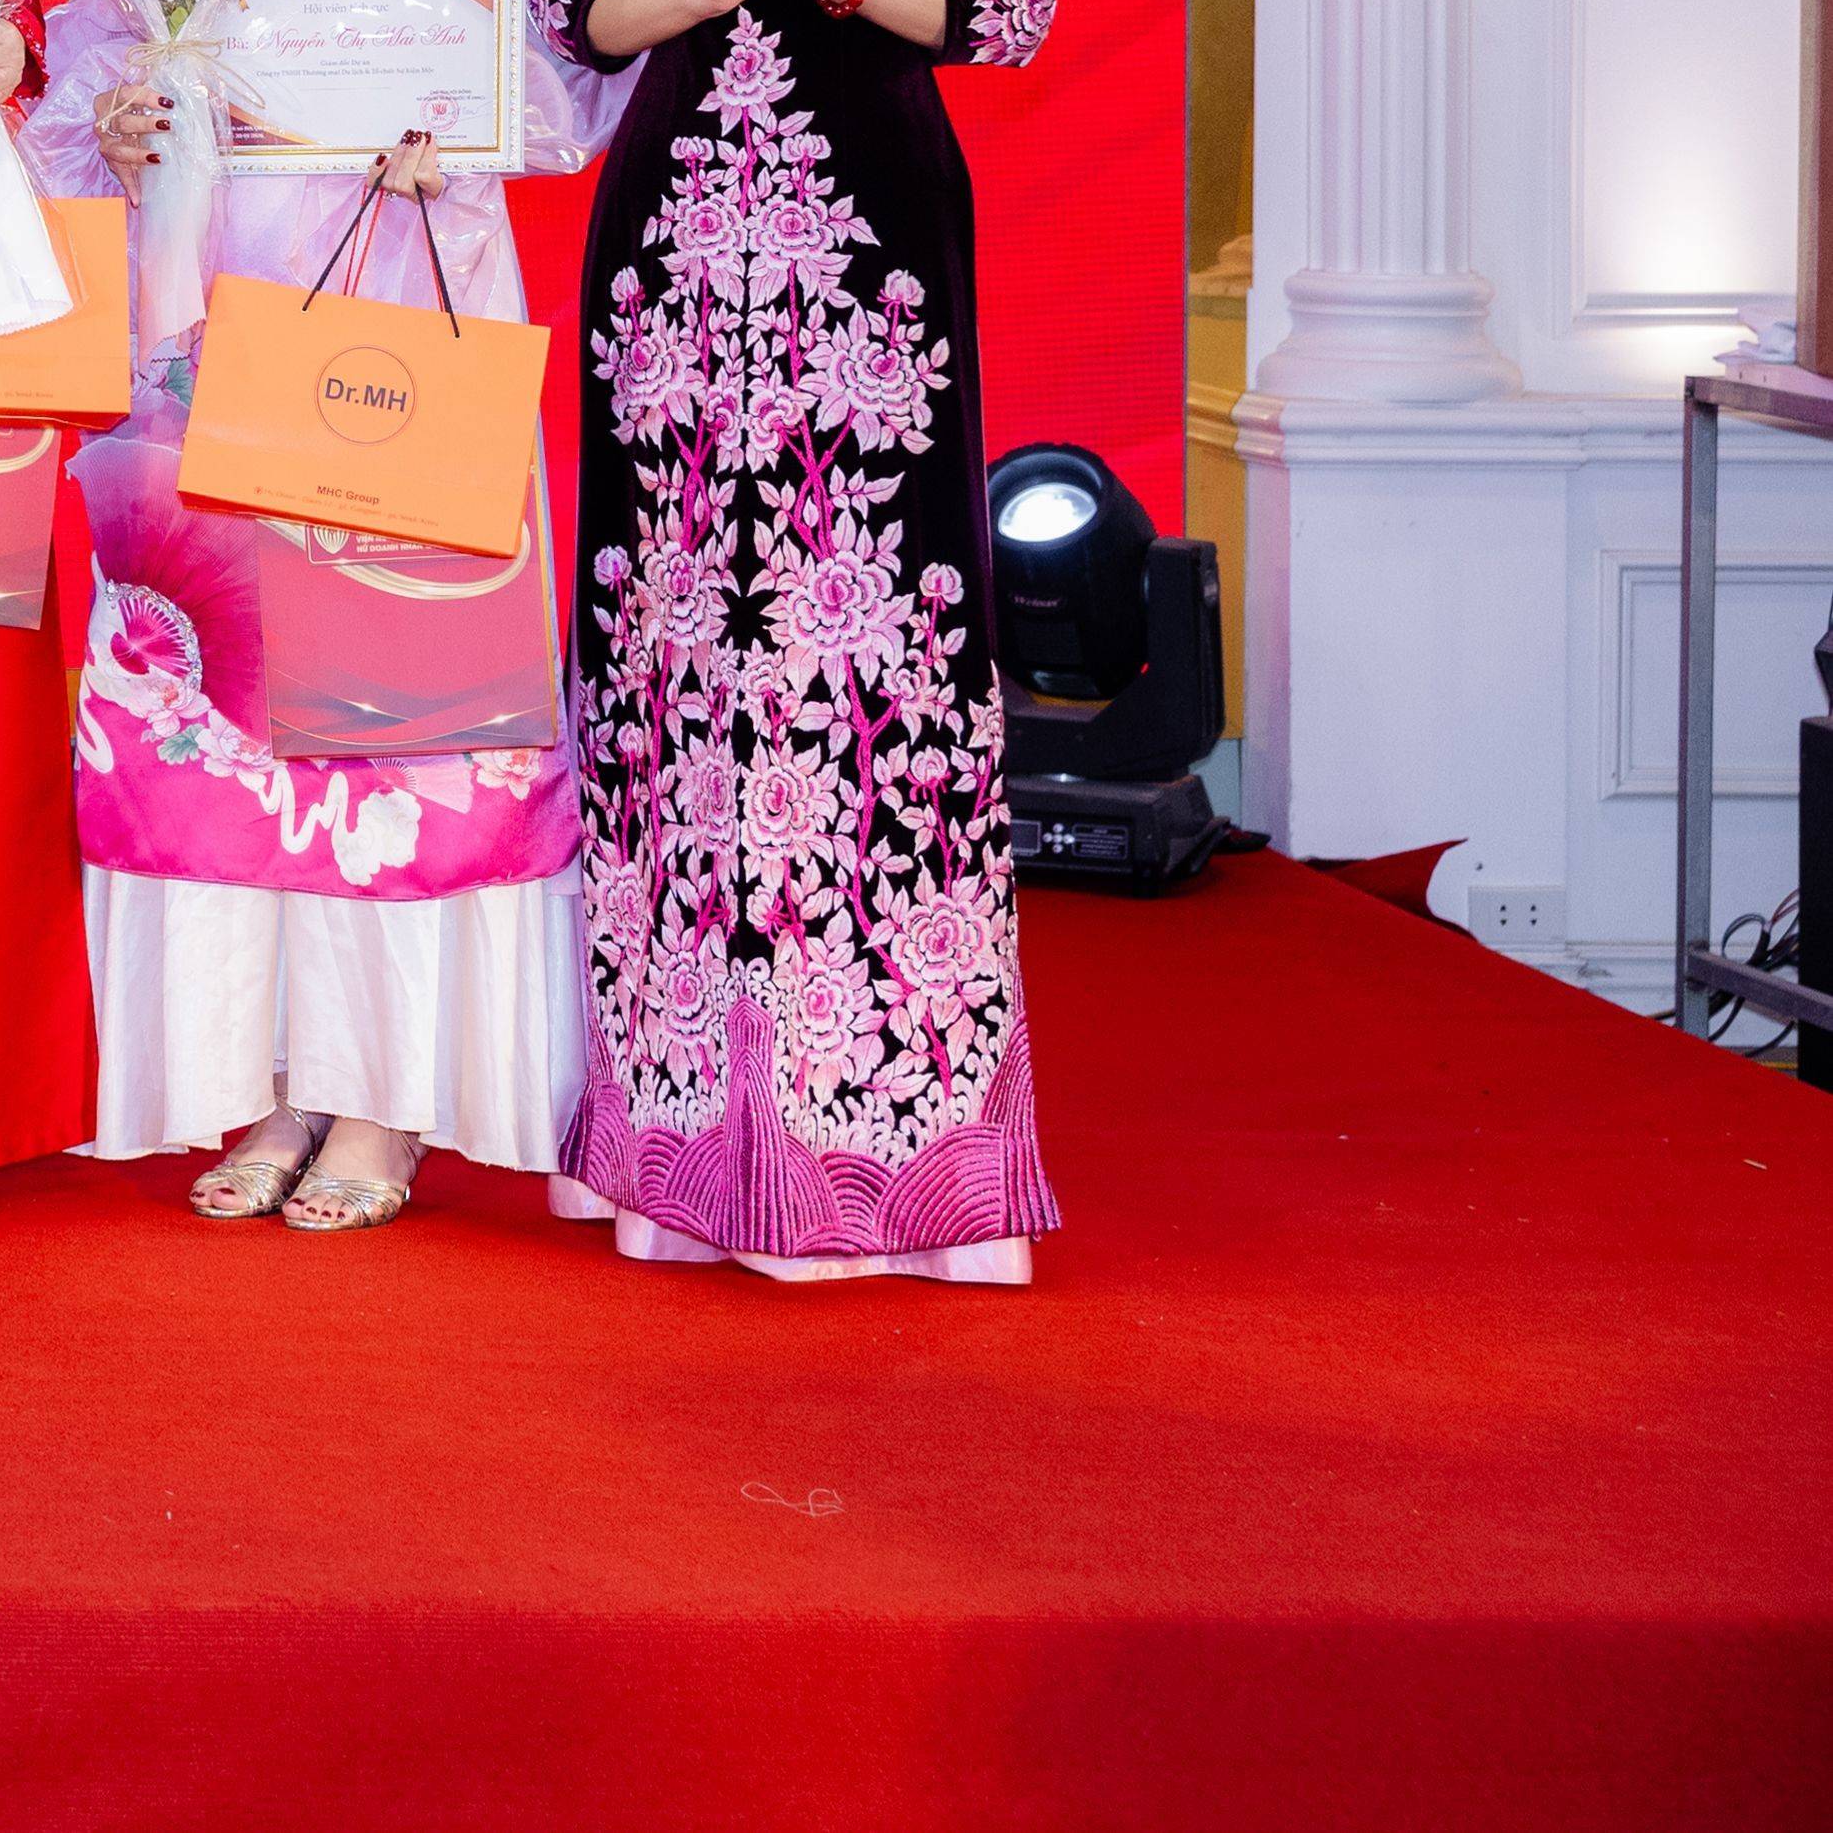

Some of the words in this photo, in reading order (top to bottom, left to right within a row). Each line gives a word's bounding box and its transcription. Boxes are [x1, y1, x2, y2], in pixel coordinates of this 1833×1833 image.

[303, 3, 323, 15] Hội
[325, 3, 347, 14] viên
[325, 377, 407, 413] Dr.MH
[316, 485, 342, 498] MHC
[345, 490, 381, 506] Group
